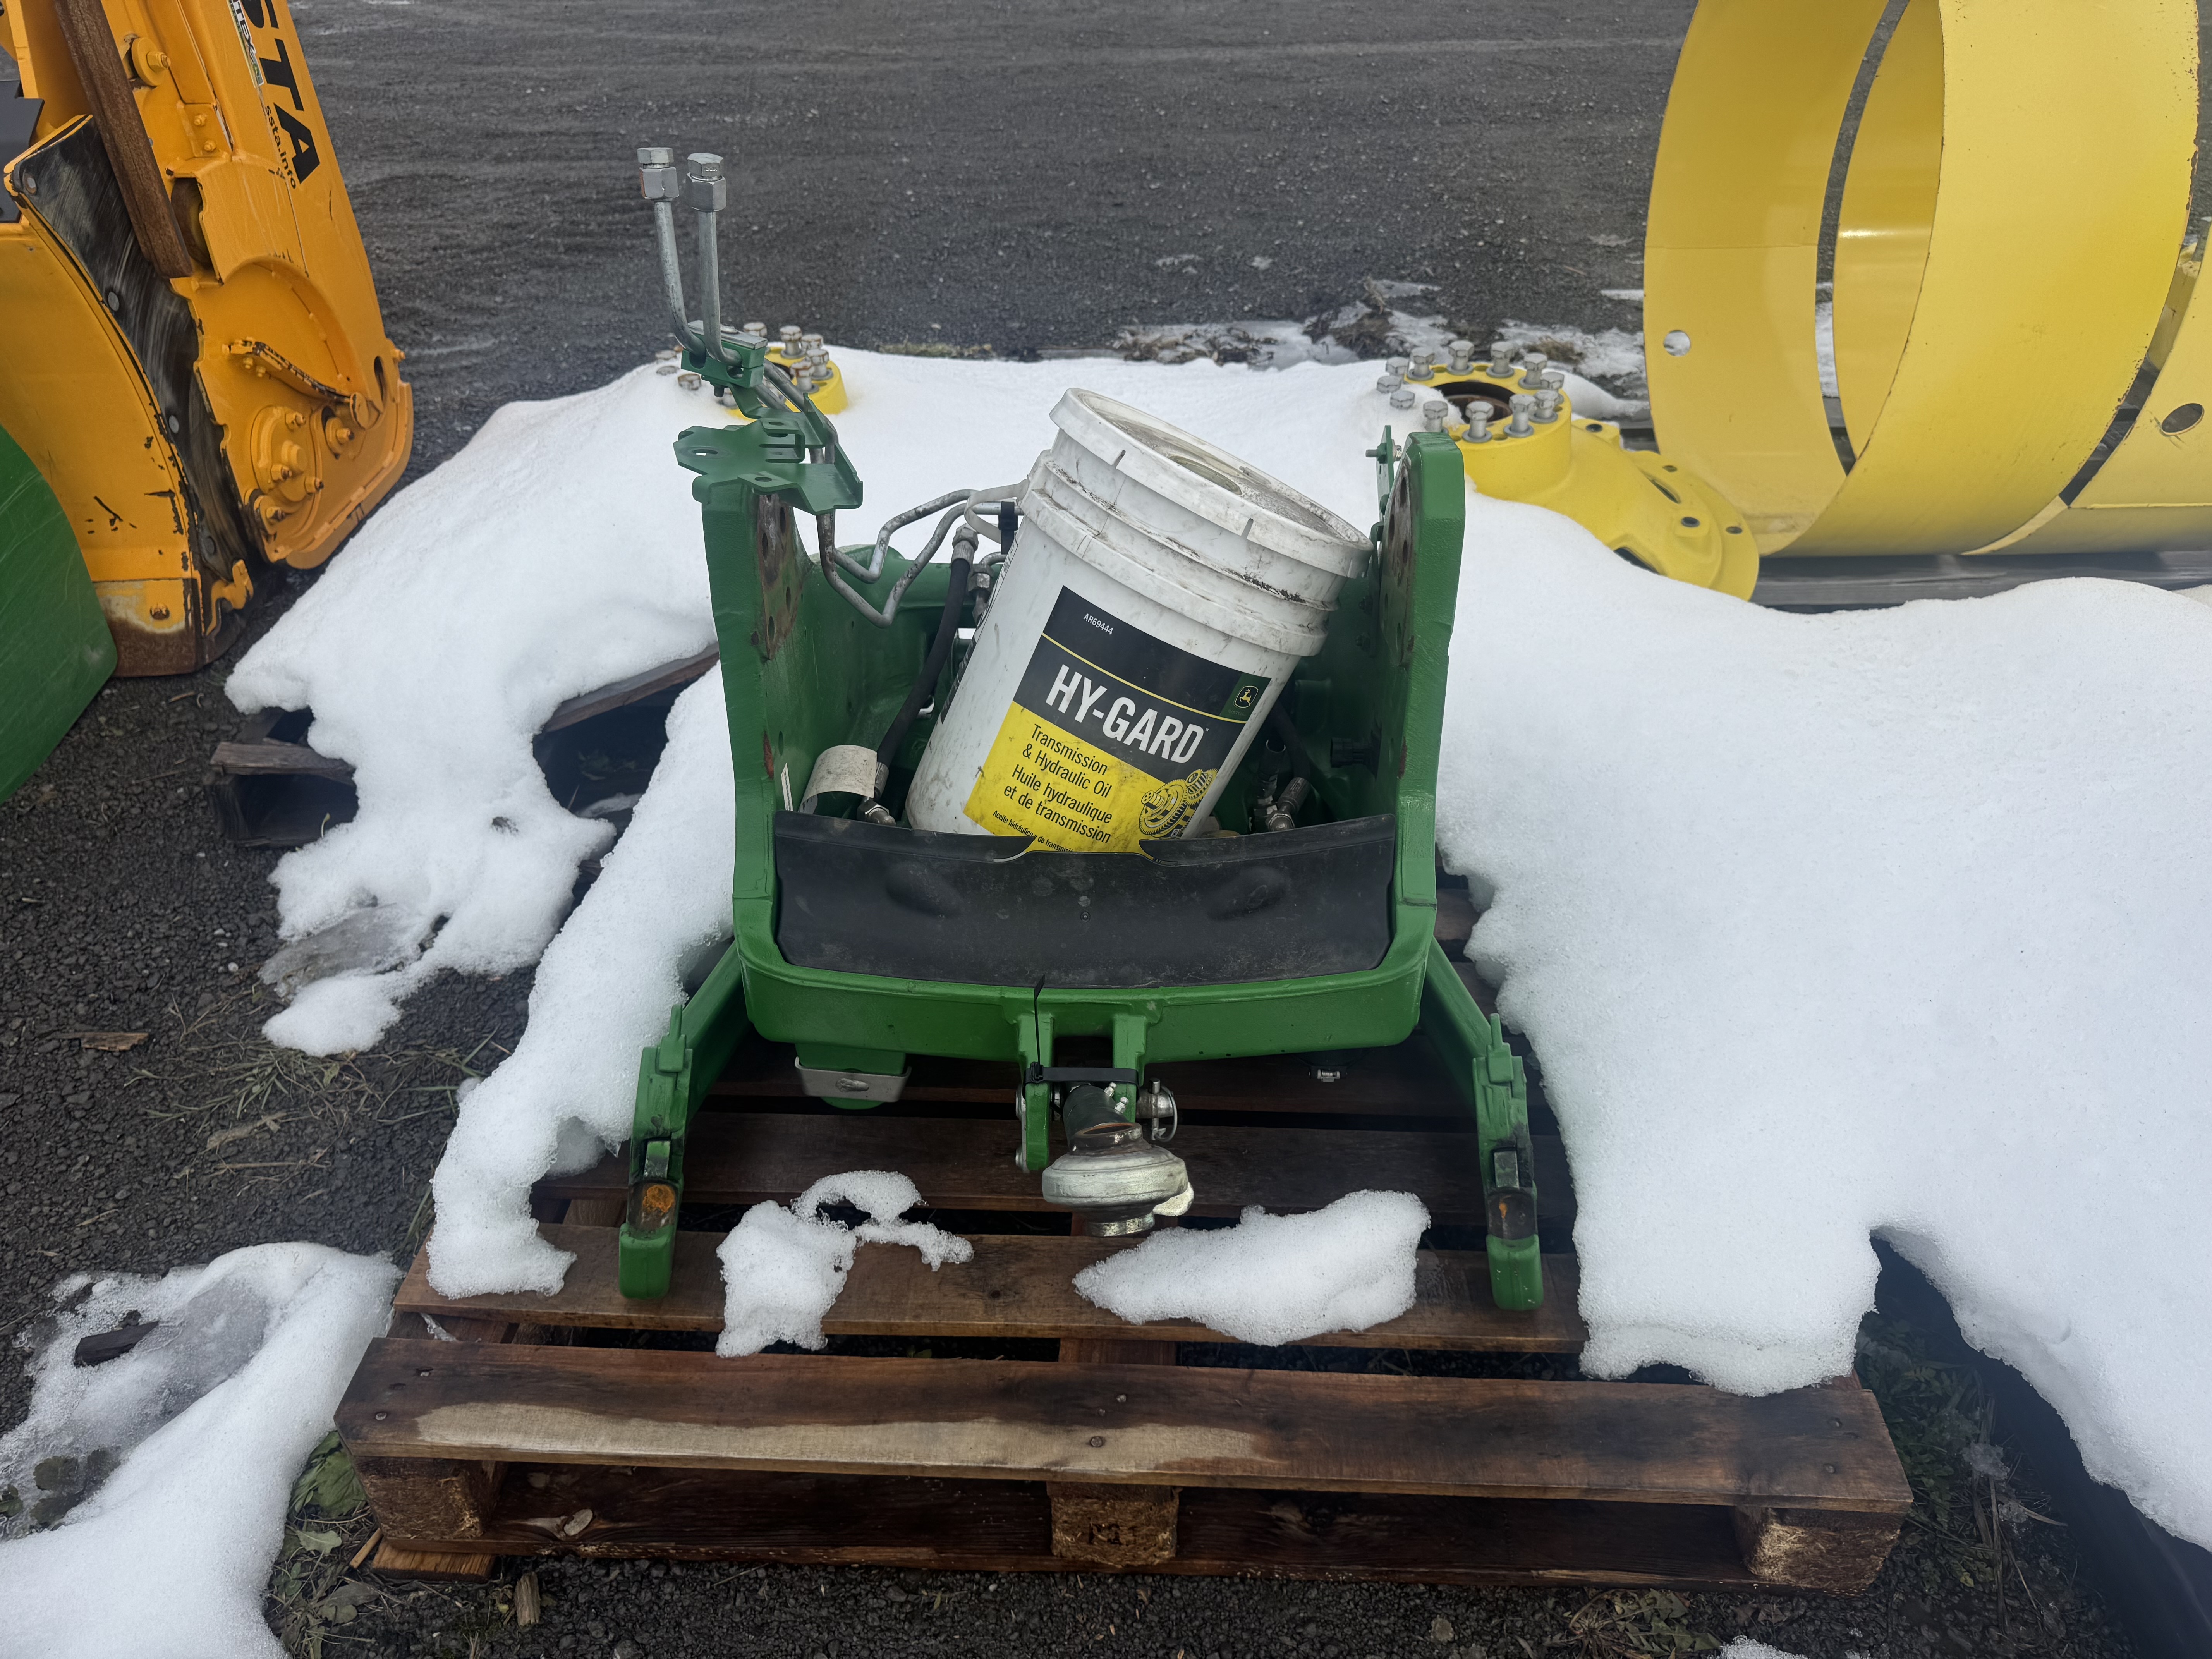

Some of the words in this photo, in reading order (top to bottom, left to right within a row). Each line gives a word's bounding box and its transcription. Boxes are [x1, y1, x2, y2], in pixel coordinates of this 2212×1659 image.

[265, 105, 296, 189] ssta.info
[1083, 613, 1113, 635] AR69444
[1046, 664, 1204, 763] HY-GARD
[1022, 743, 1032, 759] &
[1034, 750, 1091, 789] Hydraulic
[1093, 780, 1112, 798] Oil
[1031, 723, 1108, 776] Transmission
[1004, 785, 1017, 799] et
[1018, 793, 1033, 809] de
[1035, 800, 1111, 843] transmission
[1012, 764, 1041, 791] Huile
[1042, 782, 1112, 823] hydraulique
[993, 810, 1008, 823] Aceite
[1008, 819, 1033, 836] hidráulico
